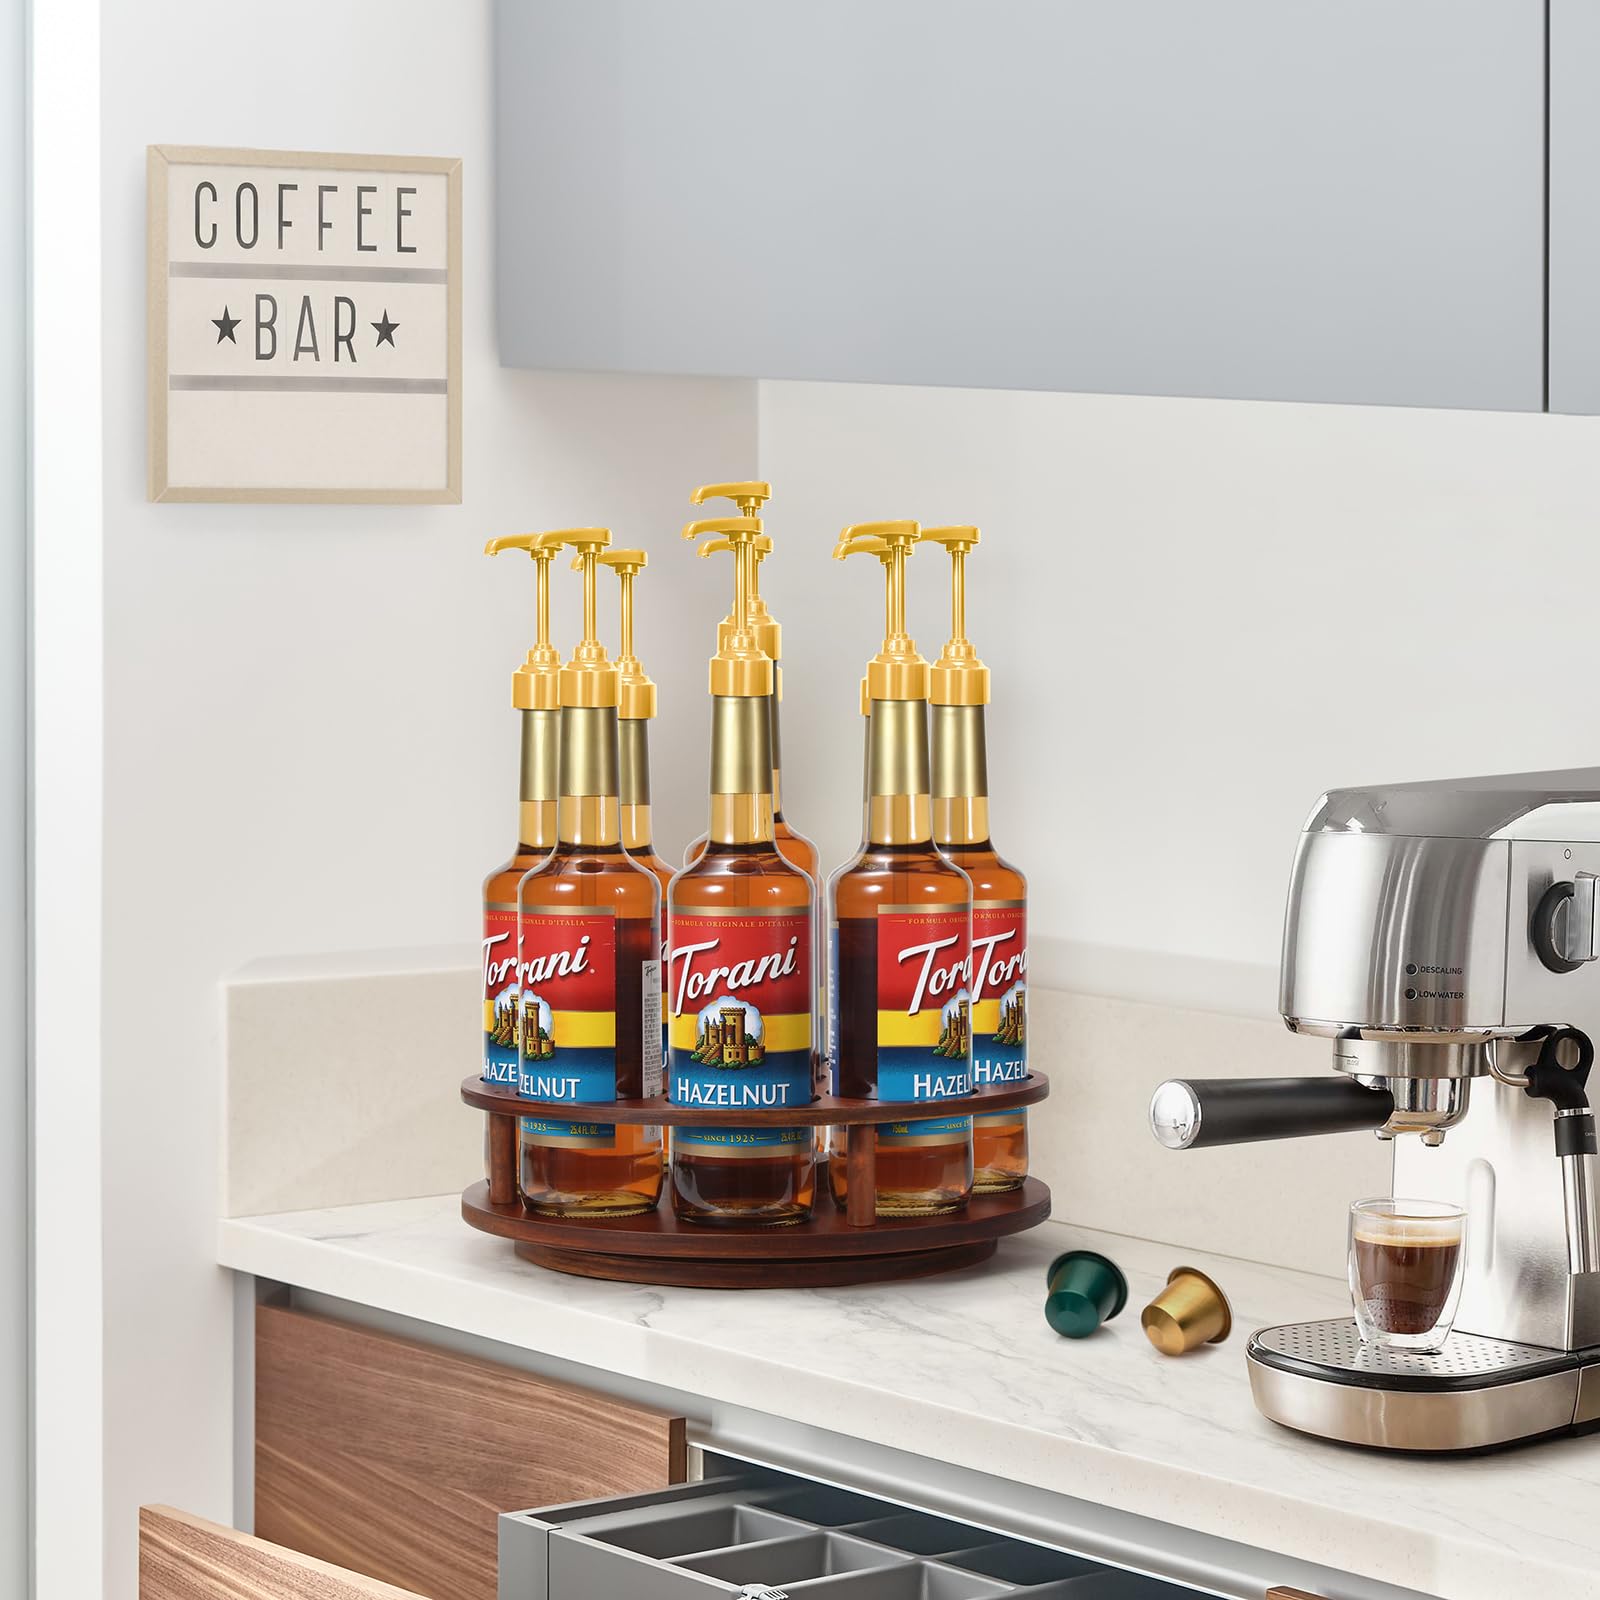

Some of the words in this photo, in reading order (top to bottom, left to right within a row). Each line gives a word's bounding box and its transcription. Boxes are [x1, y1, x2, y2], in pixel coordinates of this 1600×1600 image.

[194, 181, 417, 253] COFFEE
[255, 293, 357, 362] BAR
[908, 915, 947, 924] FORMULA
[973, 911, 1006, 920] ORMULA
[548, 919, 585, 927] D'ITALIA
[482, 930, 519, 998] Tor
[518, 935, 590, 988] rani
[1420, 966, 1463, 975] DESCALING
[671, 935, 797, 1017] Torani
[1419, 990, 1437, 998] LOW
[1437, 991, 1464, 999] WATER
[677, 1077, 790, 1105] HAZELNUT
[530, 1122, 547, 1132] 1925
[703, 1134, 726, 1142] SINCE
[729, 1134, 755, 1143] 1925
